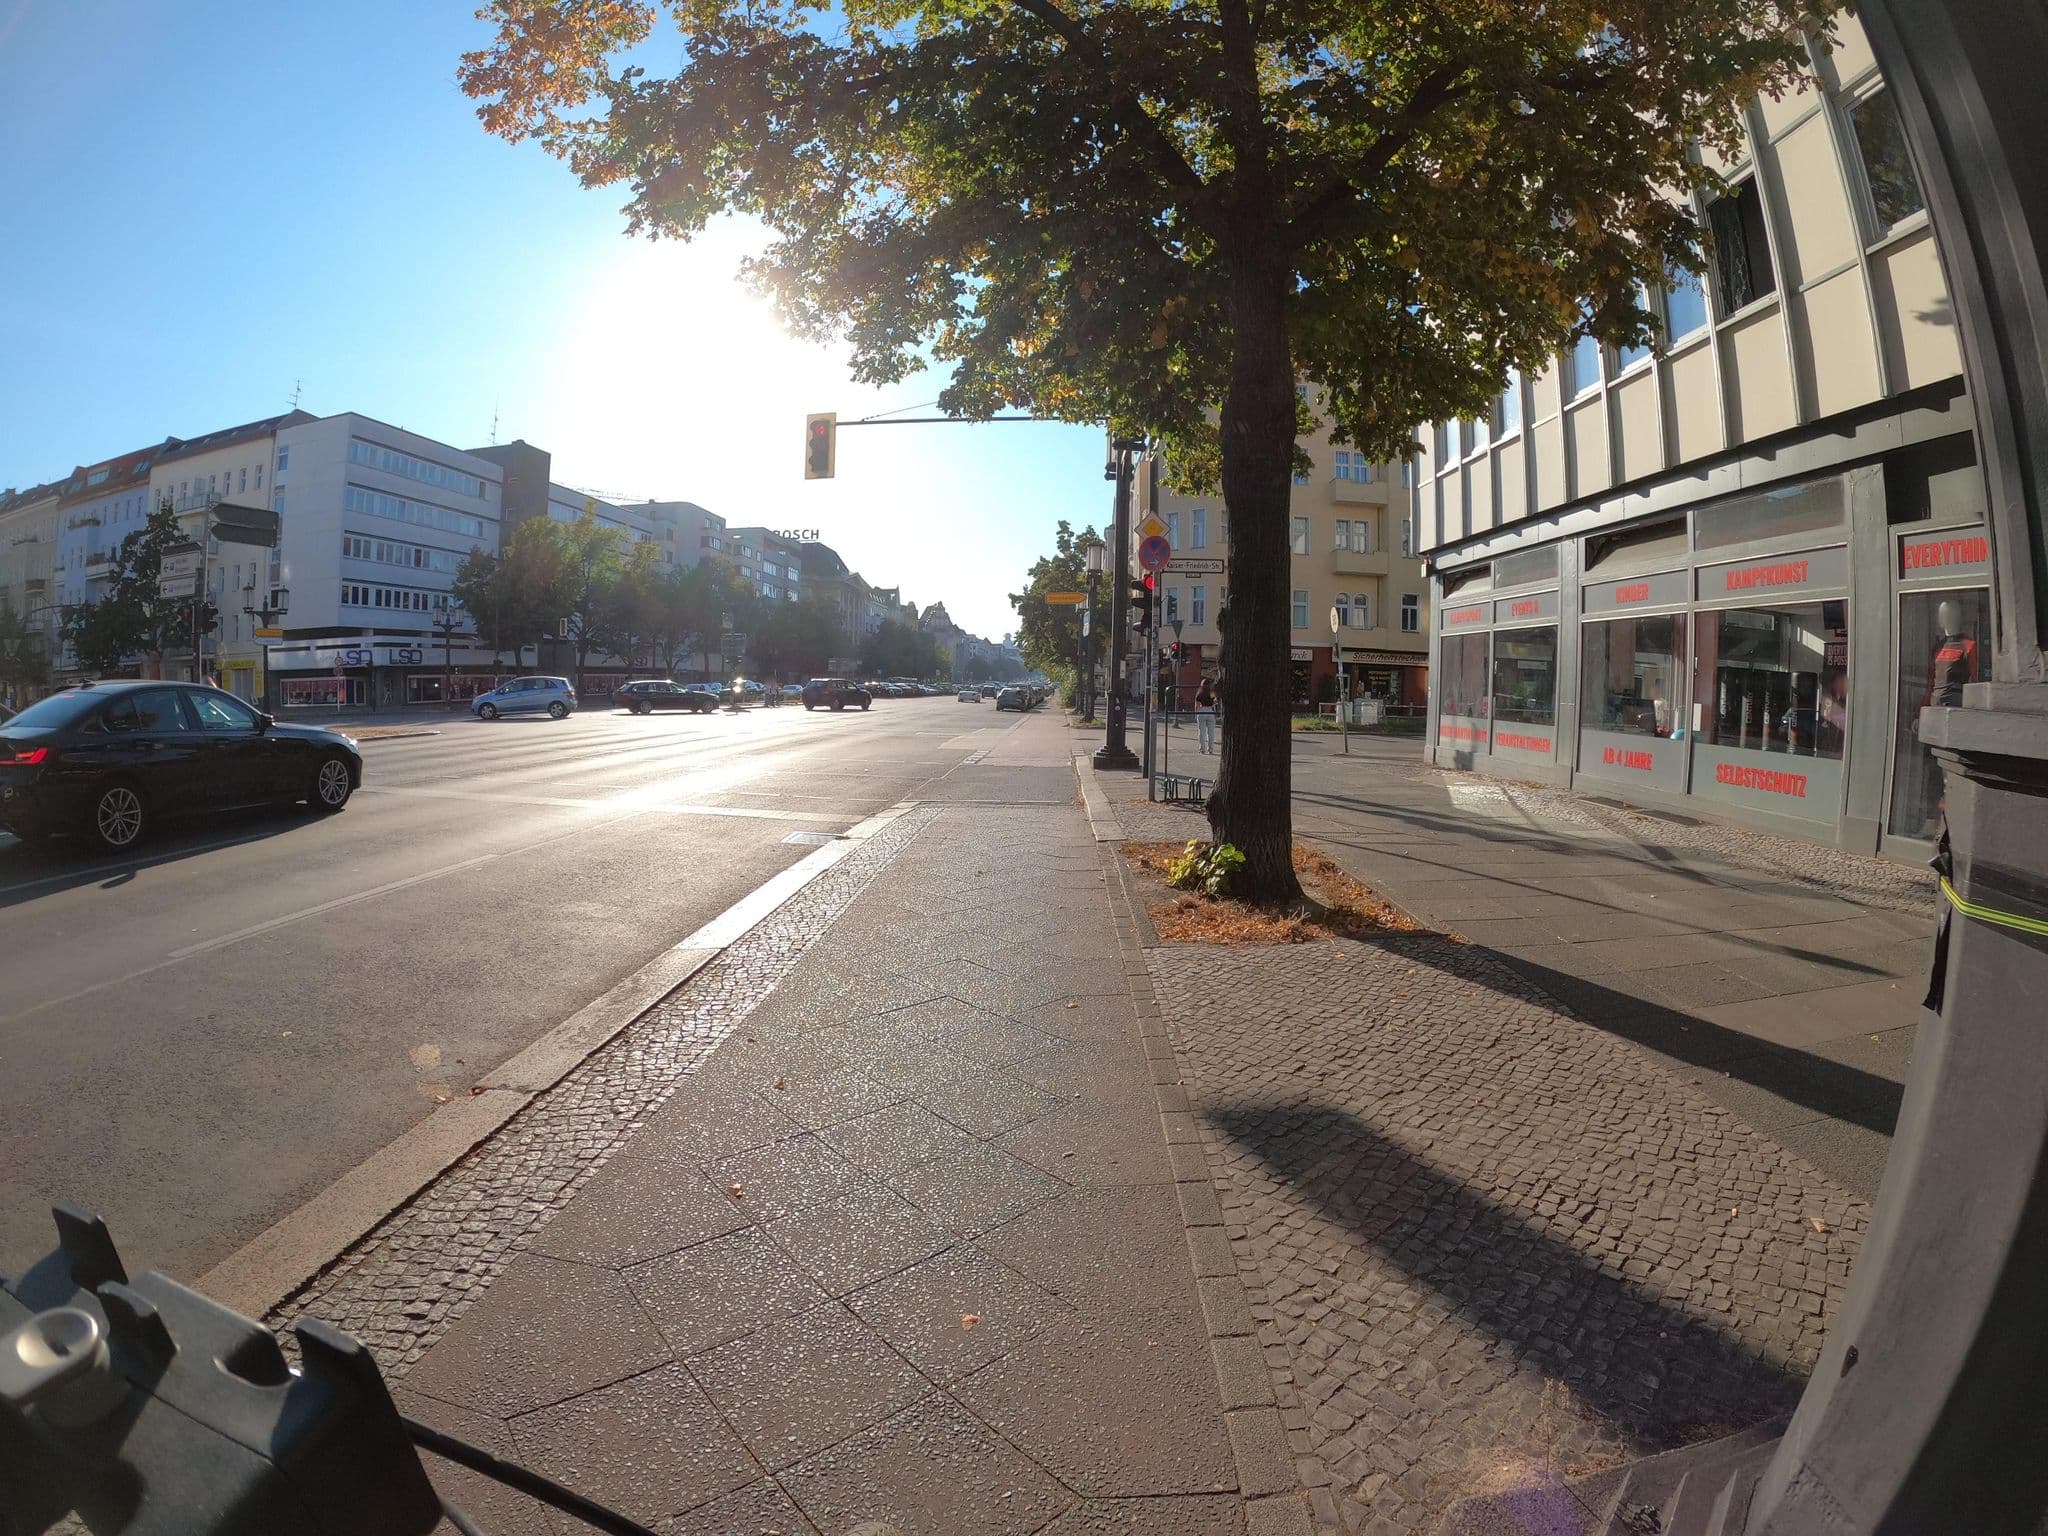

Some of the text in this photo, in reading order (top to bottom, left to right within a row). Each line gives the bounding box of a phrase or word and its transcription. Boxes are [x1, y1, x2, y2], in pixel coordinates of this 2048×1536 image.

[1726, 560, 1808, 590] KAMPFKUNST
[1616, 583, 1648, 604] KINDER
[389, 649, 423, 665] LSD
[1603, 747, 1653, 770] AB 4 JAHRE
[1716, 763, 1807, 798] SELBSTSCHUTZ
